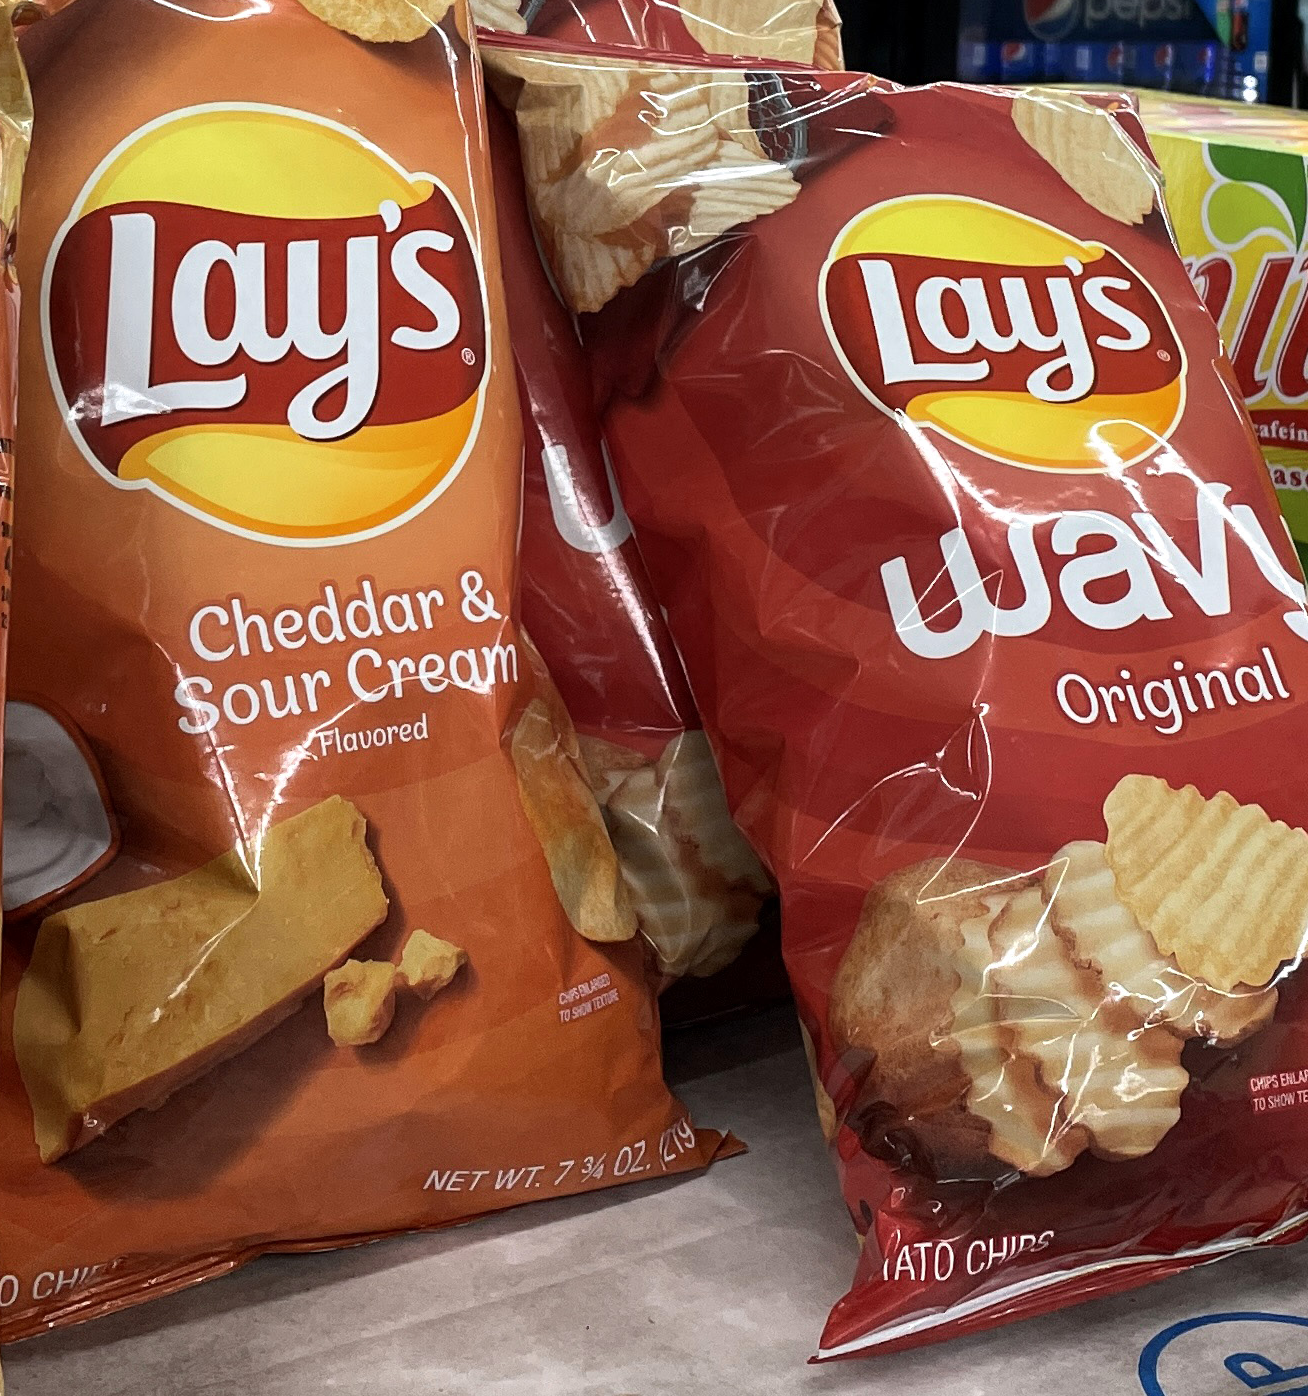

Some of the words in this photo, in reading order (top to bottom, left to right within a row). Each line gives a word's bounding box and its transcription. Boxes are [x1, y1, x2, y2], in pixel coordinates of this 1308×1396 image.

[101, 199, 460, 439] Lay's
[858, 256, 1151, 403] Lay's
[189, 581, 444, 664] Cheddar
[461, 571, 503, 623] &
[174, 664, 334, 736] Sour
[347, 641, 519, 703] Cream
[1056, 646, 1291, 735] Original
[317, 713, 429, 759] Flavored
[558, 986, 580, 1006] CHIPS
[559, 1007, 571, 1023] TO
[1250, 1075, 1279, 1092] CHIPS
[1252, 1096, 1266, 1112] TO
[1267, 1091, 1296, 1109] SHOW
[423, 1169, 489, 1192] NET
[494, 1165, 544, 1190] WT.
[553, 1160, 575, 1186] 7
[613, 1140, 651, 1177] OZ.
[965, 1230, 1055, 1276] CHIPS
